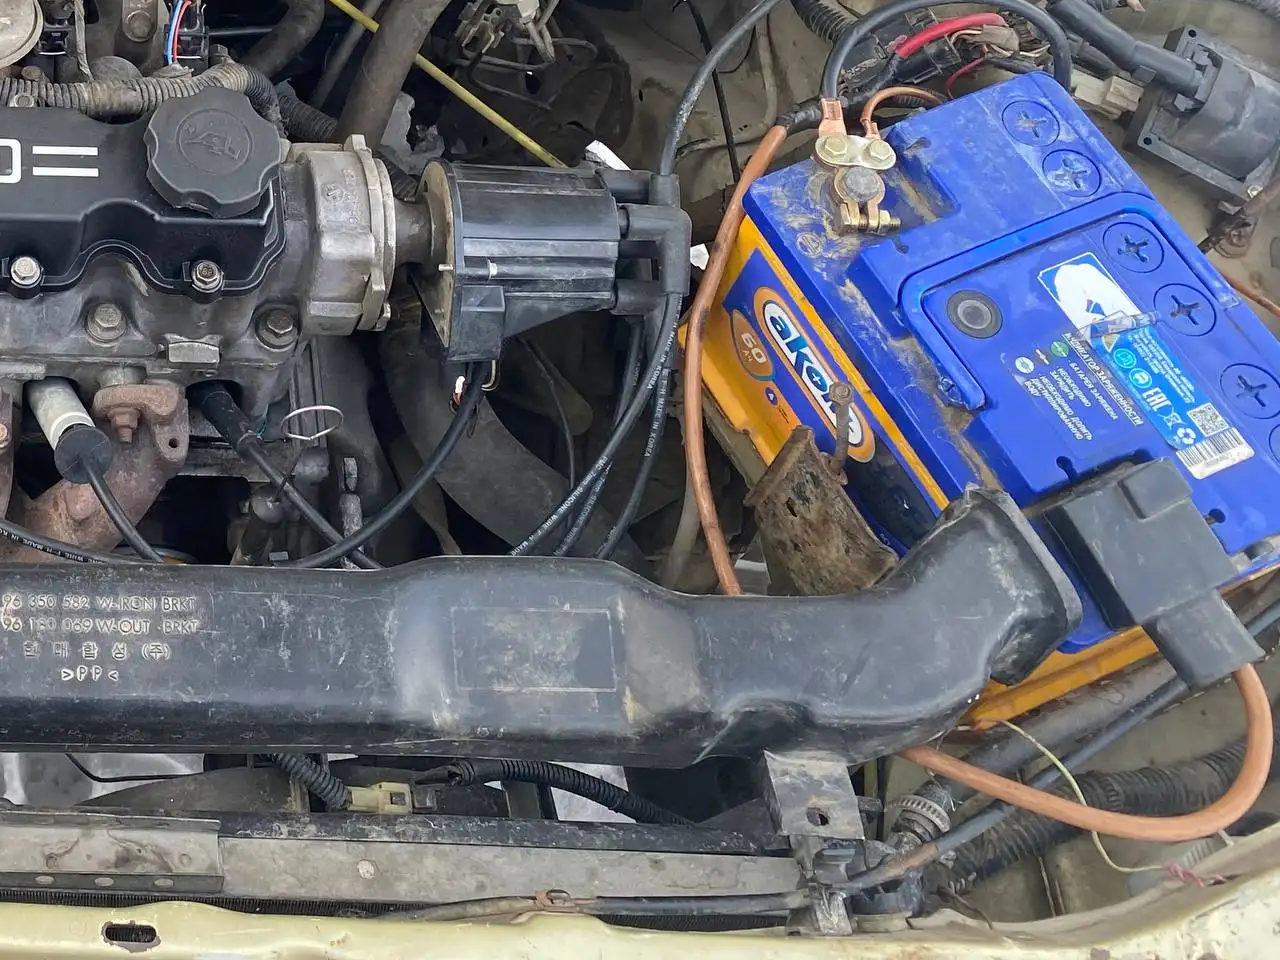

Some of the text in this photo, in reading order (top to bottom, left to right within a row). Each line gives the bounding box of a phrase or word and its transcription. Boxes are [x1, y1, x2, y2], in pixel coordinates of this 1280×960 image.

[741, 332, 767, 364] 60
[648, 365, 661, 390] KOREA
[770, 316, 854, 433] ako
[1040, 376, 1074, 416] НЕОБХОДИМО
[1057, 367, 1092, 408] НЕОБХОДИМО
[1070, 362, 1119, 421] БАТАРЕЯ ЗАРЯЖЕНА
[1098, 370, 1144, 426] ЗАРЯЖЕННОСТИ
[655, 397, 666, 418] MADE
[644, 433, 657, 457] KOREA
[595, 455, 608, 470] PMC
[559, 487, 584, 514] SILICONE
[542, 515, 558, 530] WIRE
[22, 538, 44, 552] MADE
[510, 541, 528, 557] MADE
[2, 593, 22, 610] 96
[28, 594, 56, 609] 350
[63, 595, 90, 610] 582
[162, 596, 197, 612] BRKT
[4, 617, 22, 632] 96
[29, 617, 56, 632] 180
[62, 617, 94, 632] 069
